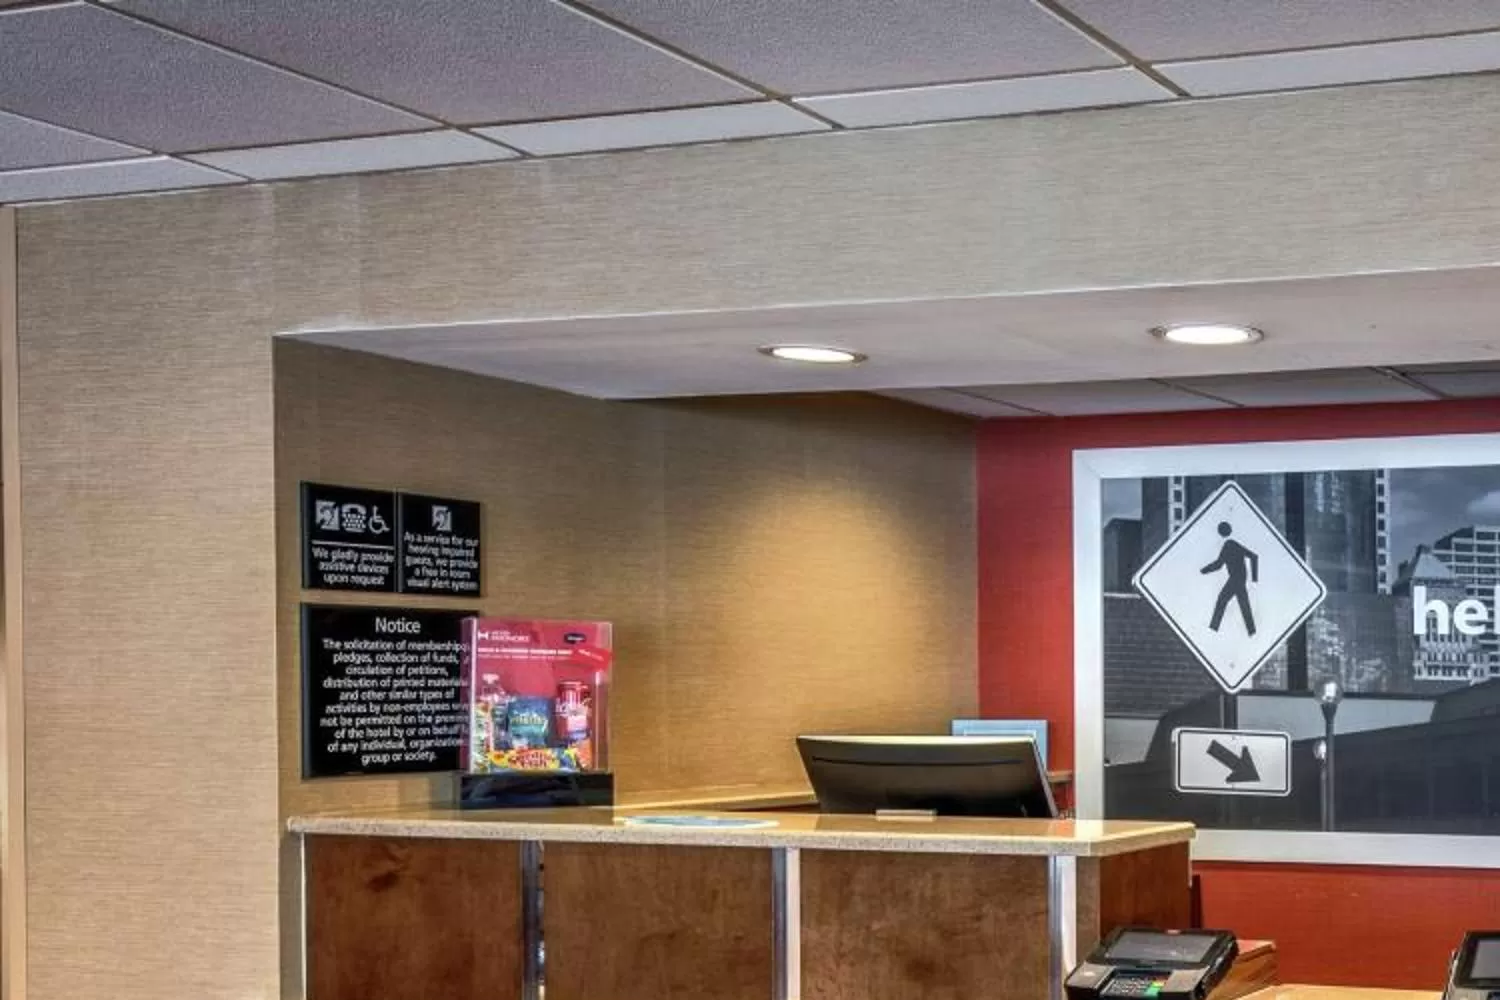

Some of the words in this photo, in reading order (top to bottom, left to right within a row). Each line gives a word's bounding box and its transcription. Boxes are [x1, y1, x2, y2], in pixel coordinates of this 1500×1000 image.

[375, 617, 421, 633] Notice
[322, 638, 341, 650] The
[343, 639, 394, 650] solicitation
[396, 640, 407, 650] of
[395, 664, 406, 675] of
